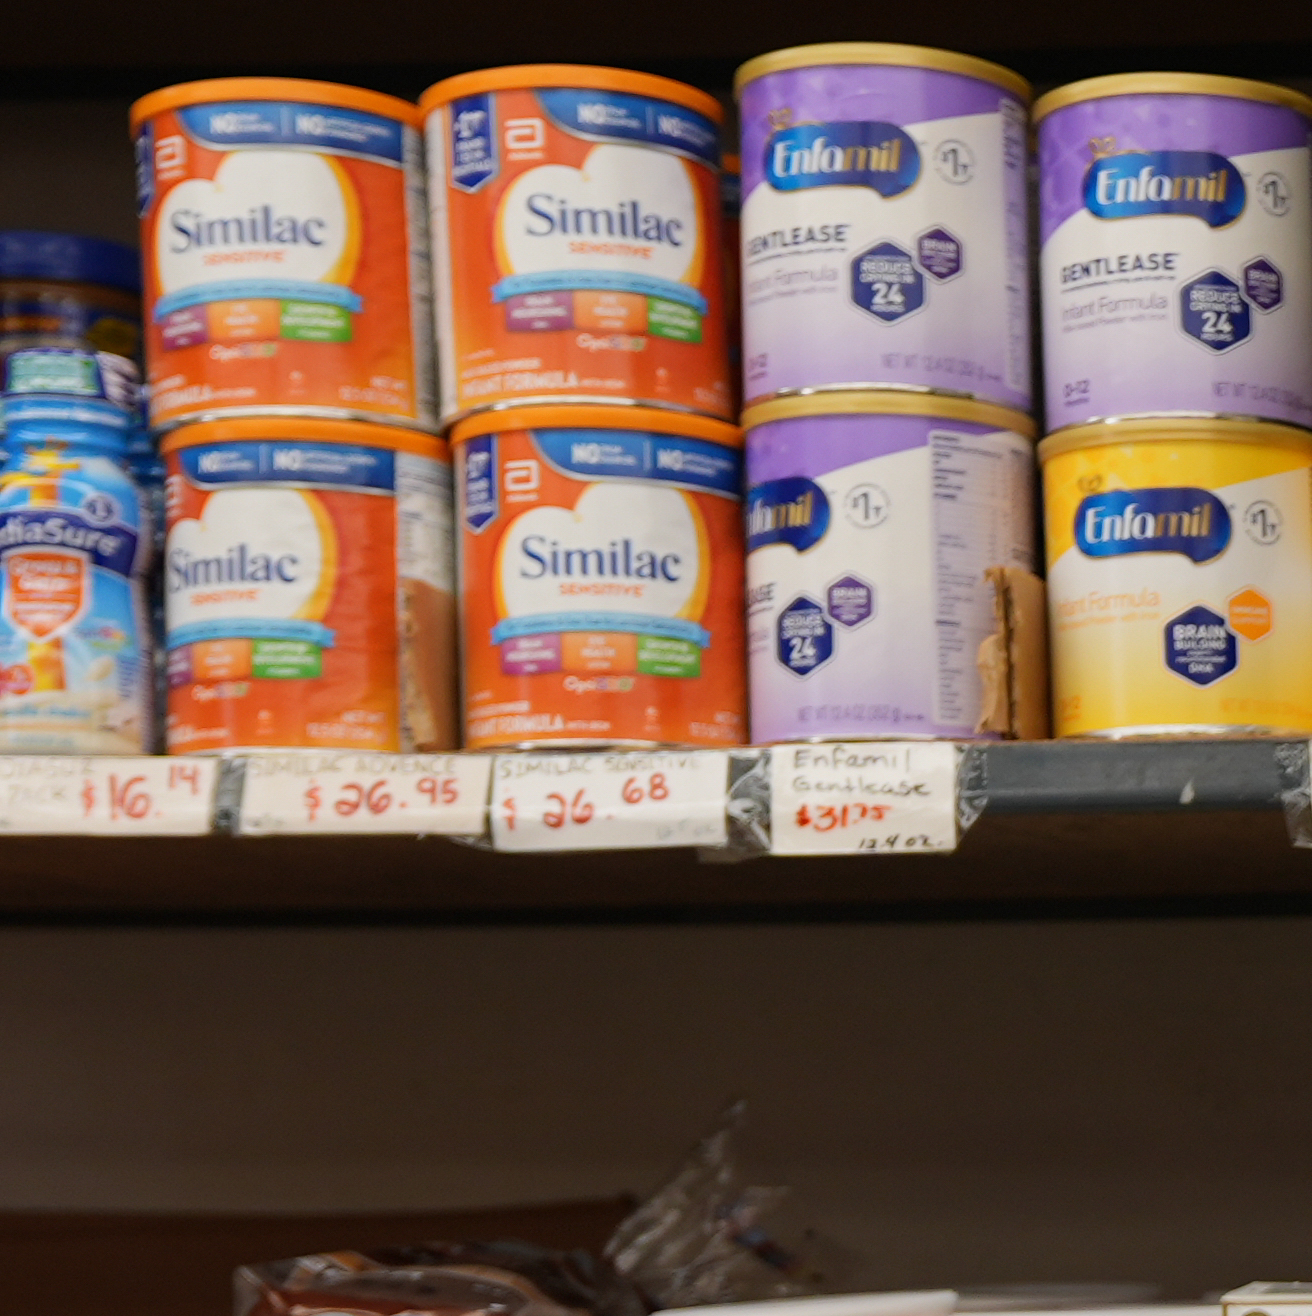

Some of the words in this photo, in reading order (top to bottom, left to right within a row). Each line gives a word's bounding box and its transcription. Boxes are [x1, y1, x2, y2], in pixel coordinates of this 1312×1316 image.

[772, 137, 900, 176] Enfamil
[1095, 170, 1227, 205] Enfamil
[170, 205, 327, 255] Similac
[524, 195, 683, 248] Similac
[1061, 252, 1176, 284] GENTLEASE
[1084, 509, 1209, 544] Enfamil
[167, 544, 298, 592] Similac
[519, 534, 681, 584] Similac
[1174, 624, 1227, 643] BRAIN
[795, 749, 911, 771] Enfamil
[334, 778, 459, 817] 26.95
